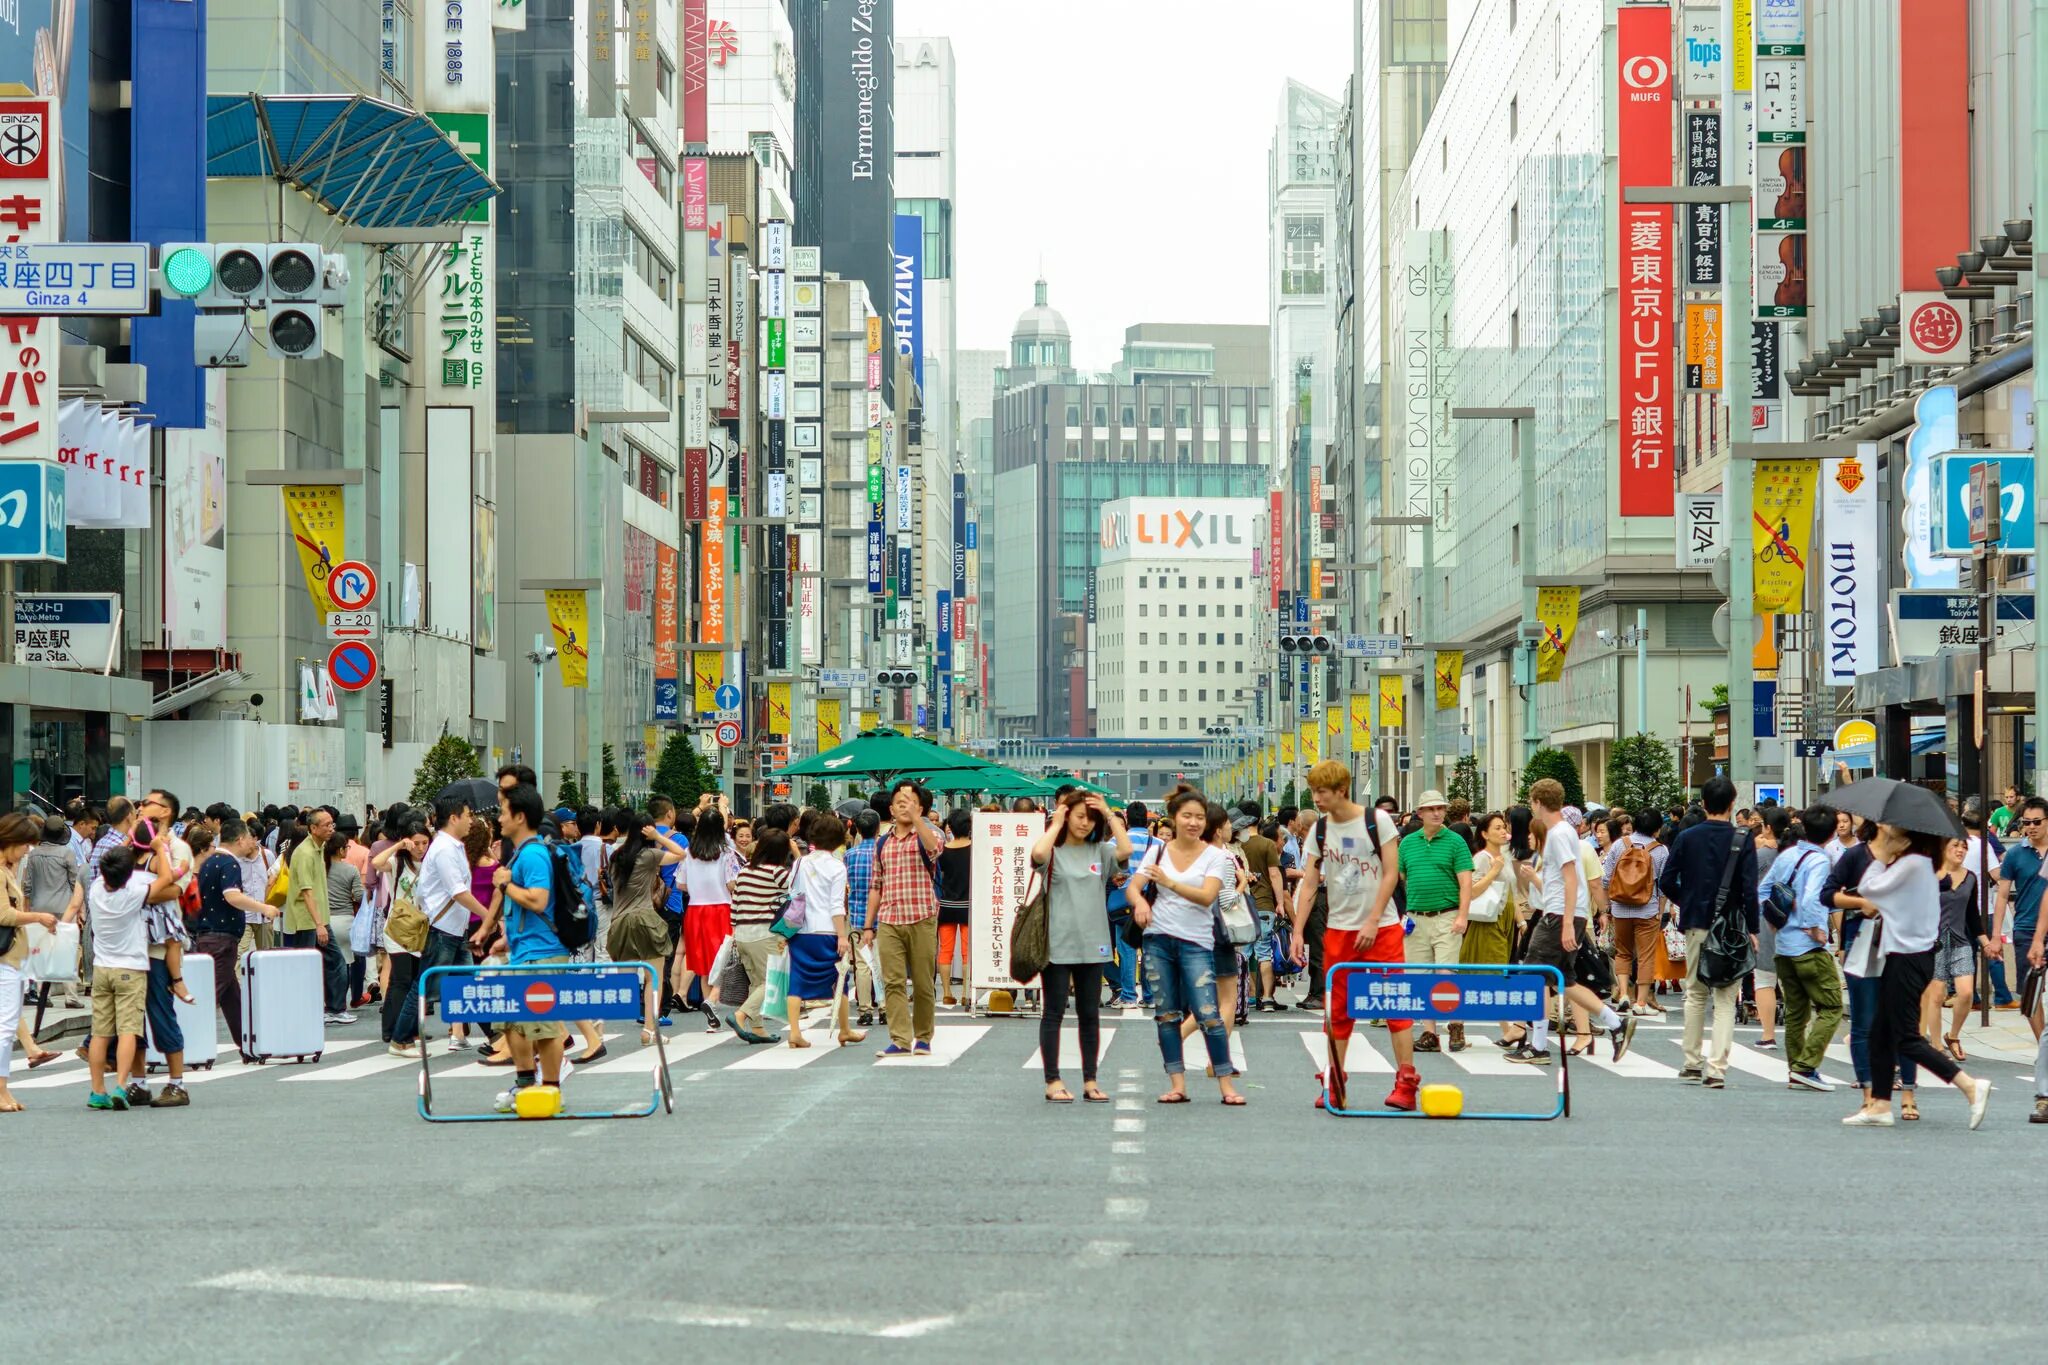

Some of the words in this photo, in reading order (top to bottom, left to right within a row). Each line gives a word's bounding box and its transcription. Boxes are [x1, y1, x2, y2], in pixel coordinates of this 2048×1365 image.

[685, 3, 705, 95] TAMAYA
[1770, 46, 1792, 55] 6F
[447, 39, 462, 84] 1885
[1631, 93, 1660, 101] MUFG
[852, 38, 879, 181] Ermenegildo
[1, 115, 39, 123] GINZA
[1692, 118, 1703, 168] 中国料理
[1773, 133, 1793, 142] 5F
[1773, 220, 1793, 229] 4F
[772, 226, 781, 265] 井上商会
[1694, 204, 1715, 281] 青百合飯荘
[26, 291, 70, 306] Ginza
[77, 291, 88, 305] 4
[470, 236, 484, 354] 子どもの本のみせ
[440, 242, 469, 386] ナルニア国
[1773, 306, 1794, 316] 3F
[708, 278, 722, 387] 日本香堂ビル
[1704, 308, 1717, 385] 輸入洋食器
[471, 361, 483, 389] 6F
[1137, 510, 1242, 549] LIXIL
[1919, 503, 1928, 541] GINZA
[870, 532, 880, 583] 洋服の青山
[955, 542, 964, 580] ALBION
[17, 614, 38, 622] Tokyo
[1830, 541, 1857, 679] MOTOKI
[1347, 640, 1398, 649] 銀座三丁目
[46, 650, 70, 662] Sta.
[720, 728, 735, 740] 50
[989, 824, 1029, 837] 警告
[992, 847, 1004, 972] 乗り入れは禁止されています。
[462, 984, 506, 999] 自転車
[559, 989, 632, 1005] 築地警察署
[1368, 982, 1412, 996] 自転車
[1354, 996, 1426, 1011] 乗入れ禁止
[1464, 990, 1537, 1006] 築地警察署
[448, 1000, 520, 1015] 乗入れ禁止
